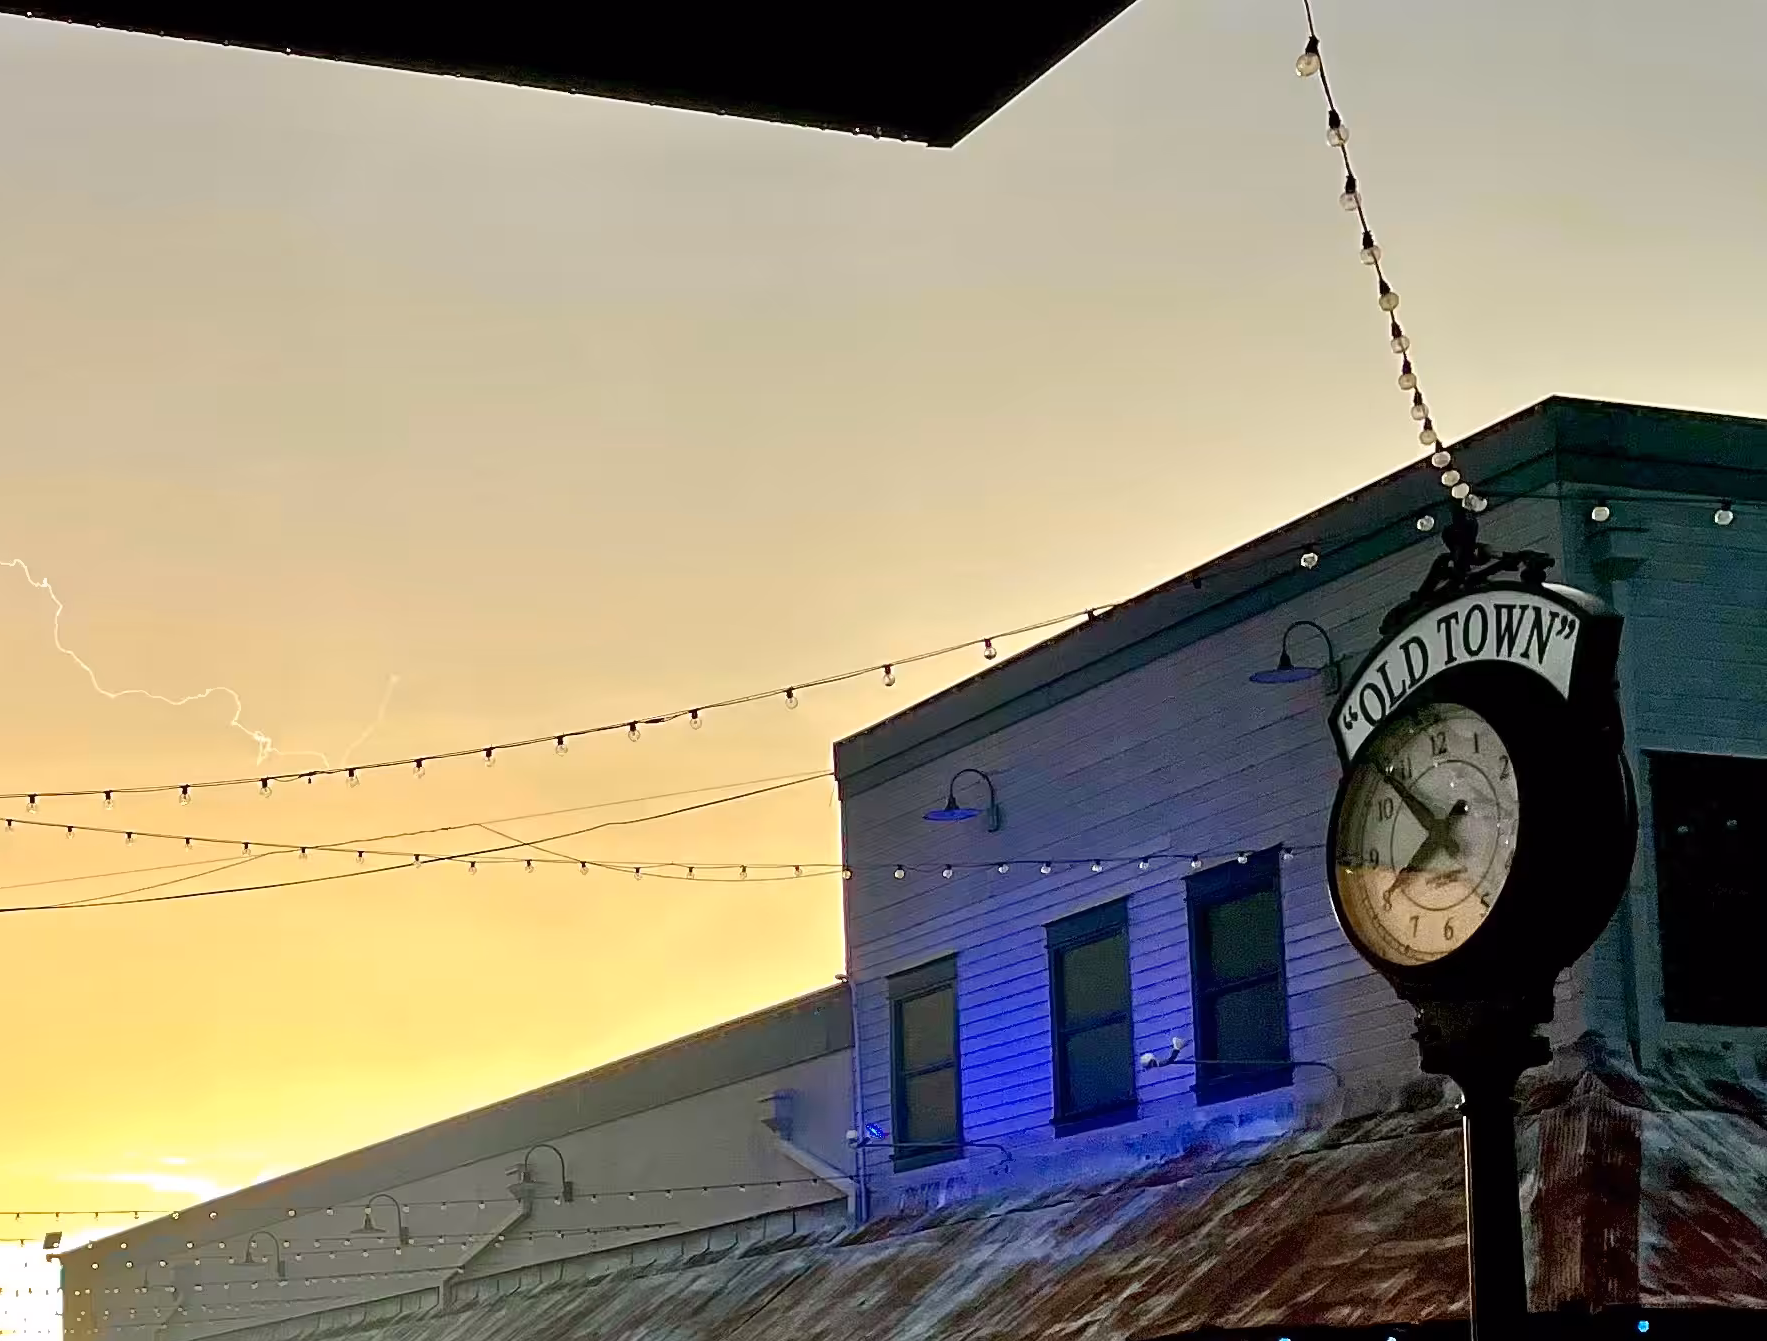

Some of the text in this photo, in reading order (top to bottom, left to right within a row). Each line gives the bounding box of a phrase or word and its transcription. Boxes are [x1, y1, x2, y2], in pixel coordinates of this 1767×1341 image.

[1430, 732, 1447, 755] 12
[1473, 733, 1480, 753] 1
[1499, 755, 1509, 781] 2
[1378, 799, 1394, 820] 10
[1370, 850, 1379, 869] 9
[1383, 891, 1392, 911] 8
[1409, 915, 1420, 937] 7
[1444, 917, 1454, 940] 6
